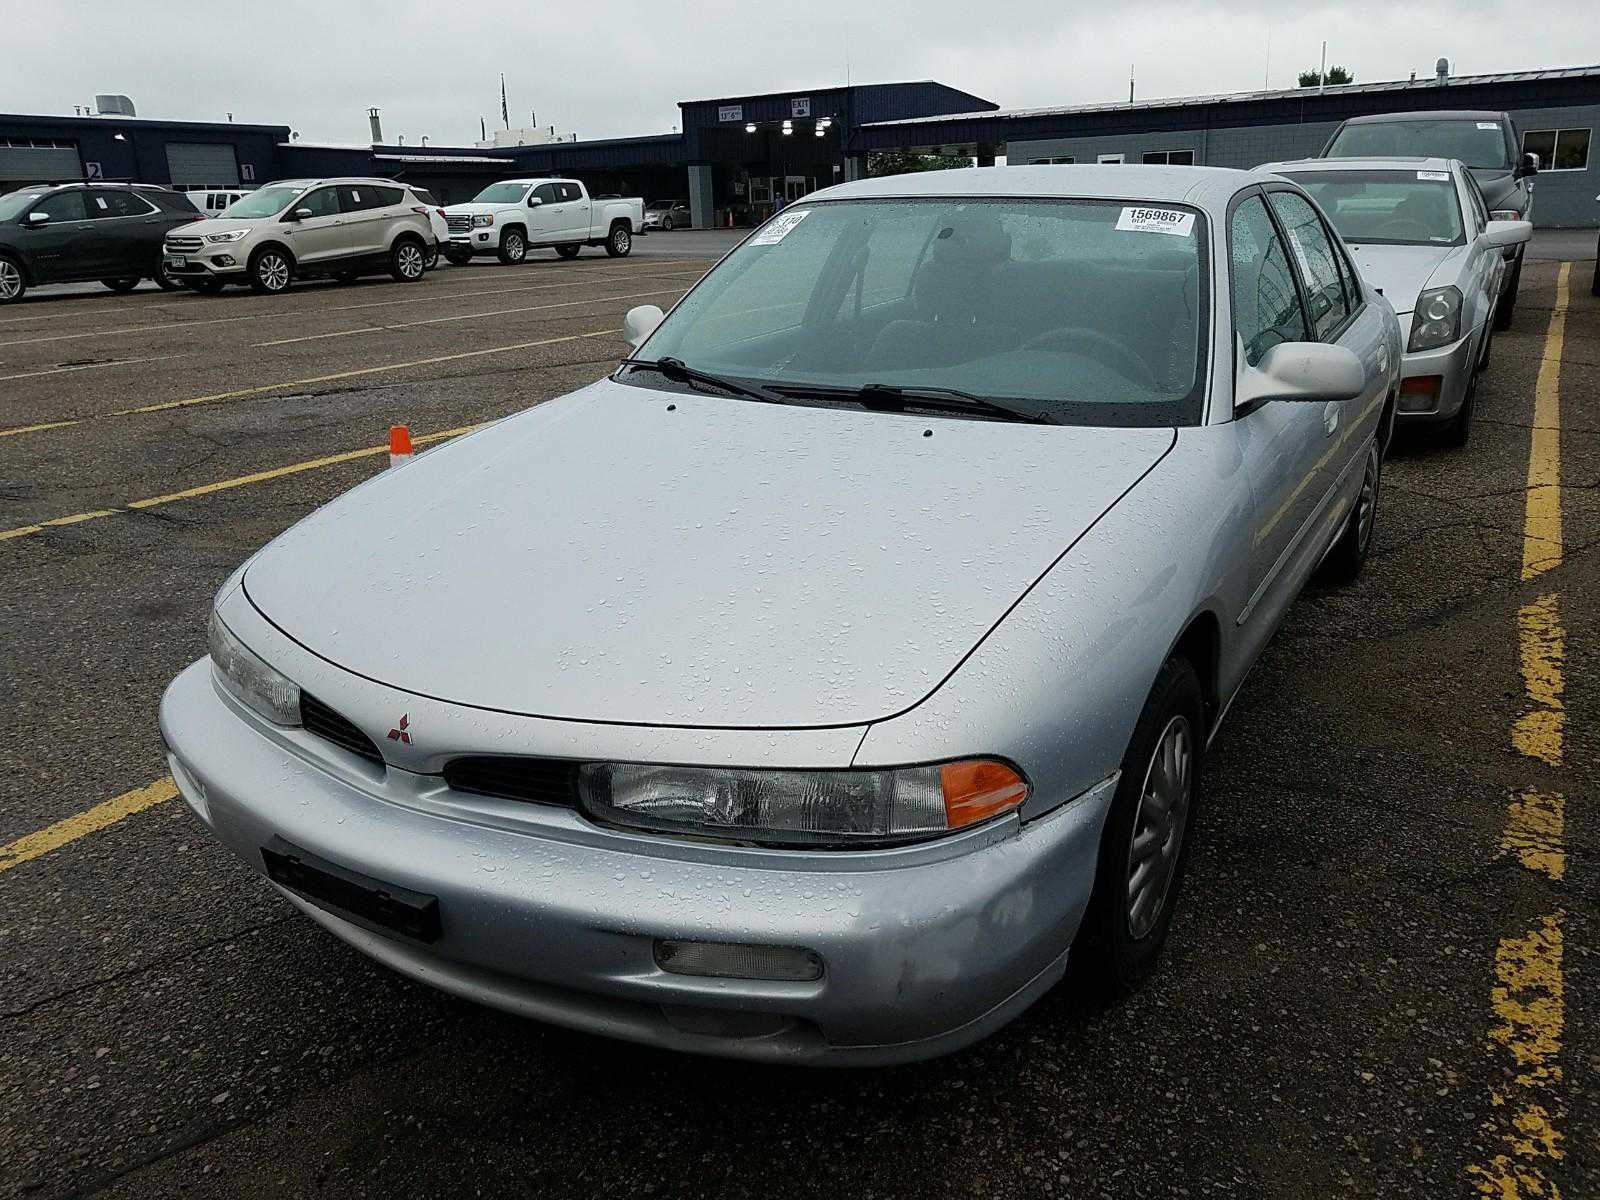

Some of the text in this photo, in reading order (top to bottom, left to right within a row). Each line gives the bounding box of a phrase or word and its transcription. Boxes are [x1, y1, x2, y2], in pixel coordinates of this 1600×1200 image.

[792, 99, 809, 109] EXIT
[88, 163, 101, 178] 2
[244, 165, 252, 180] 1
[1130, 209, 1186, 223] 1569867
